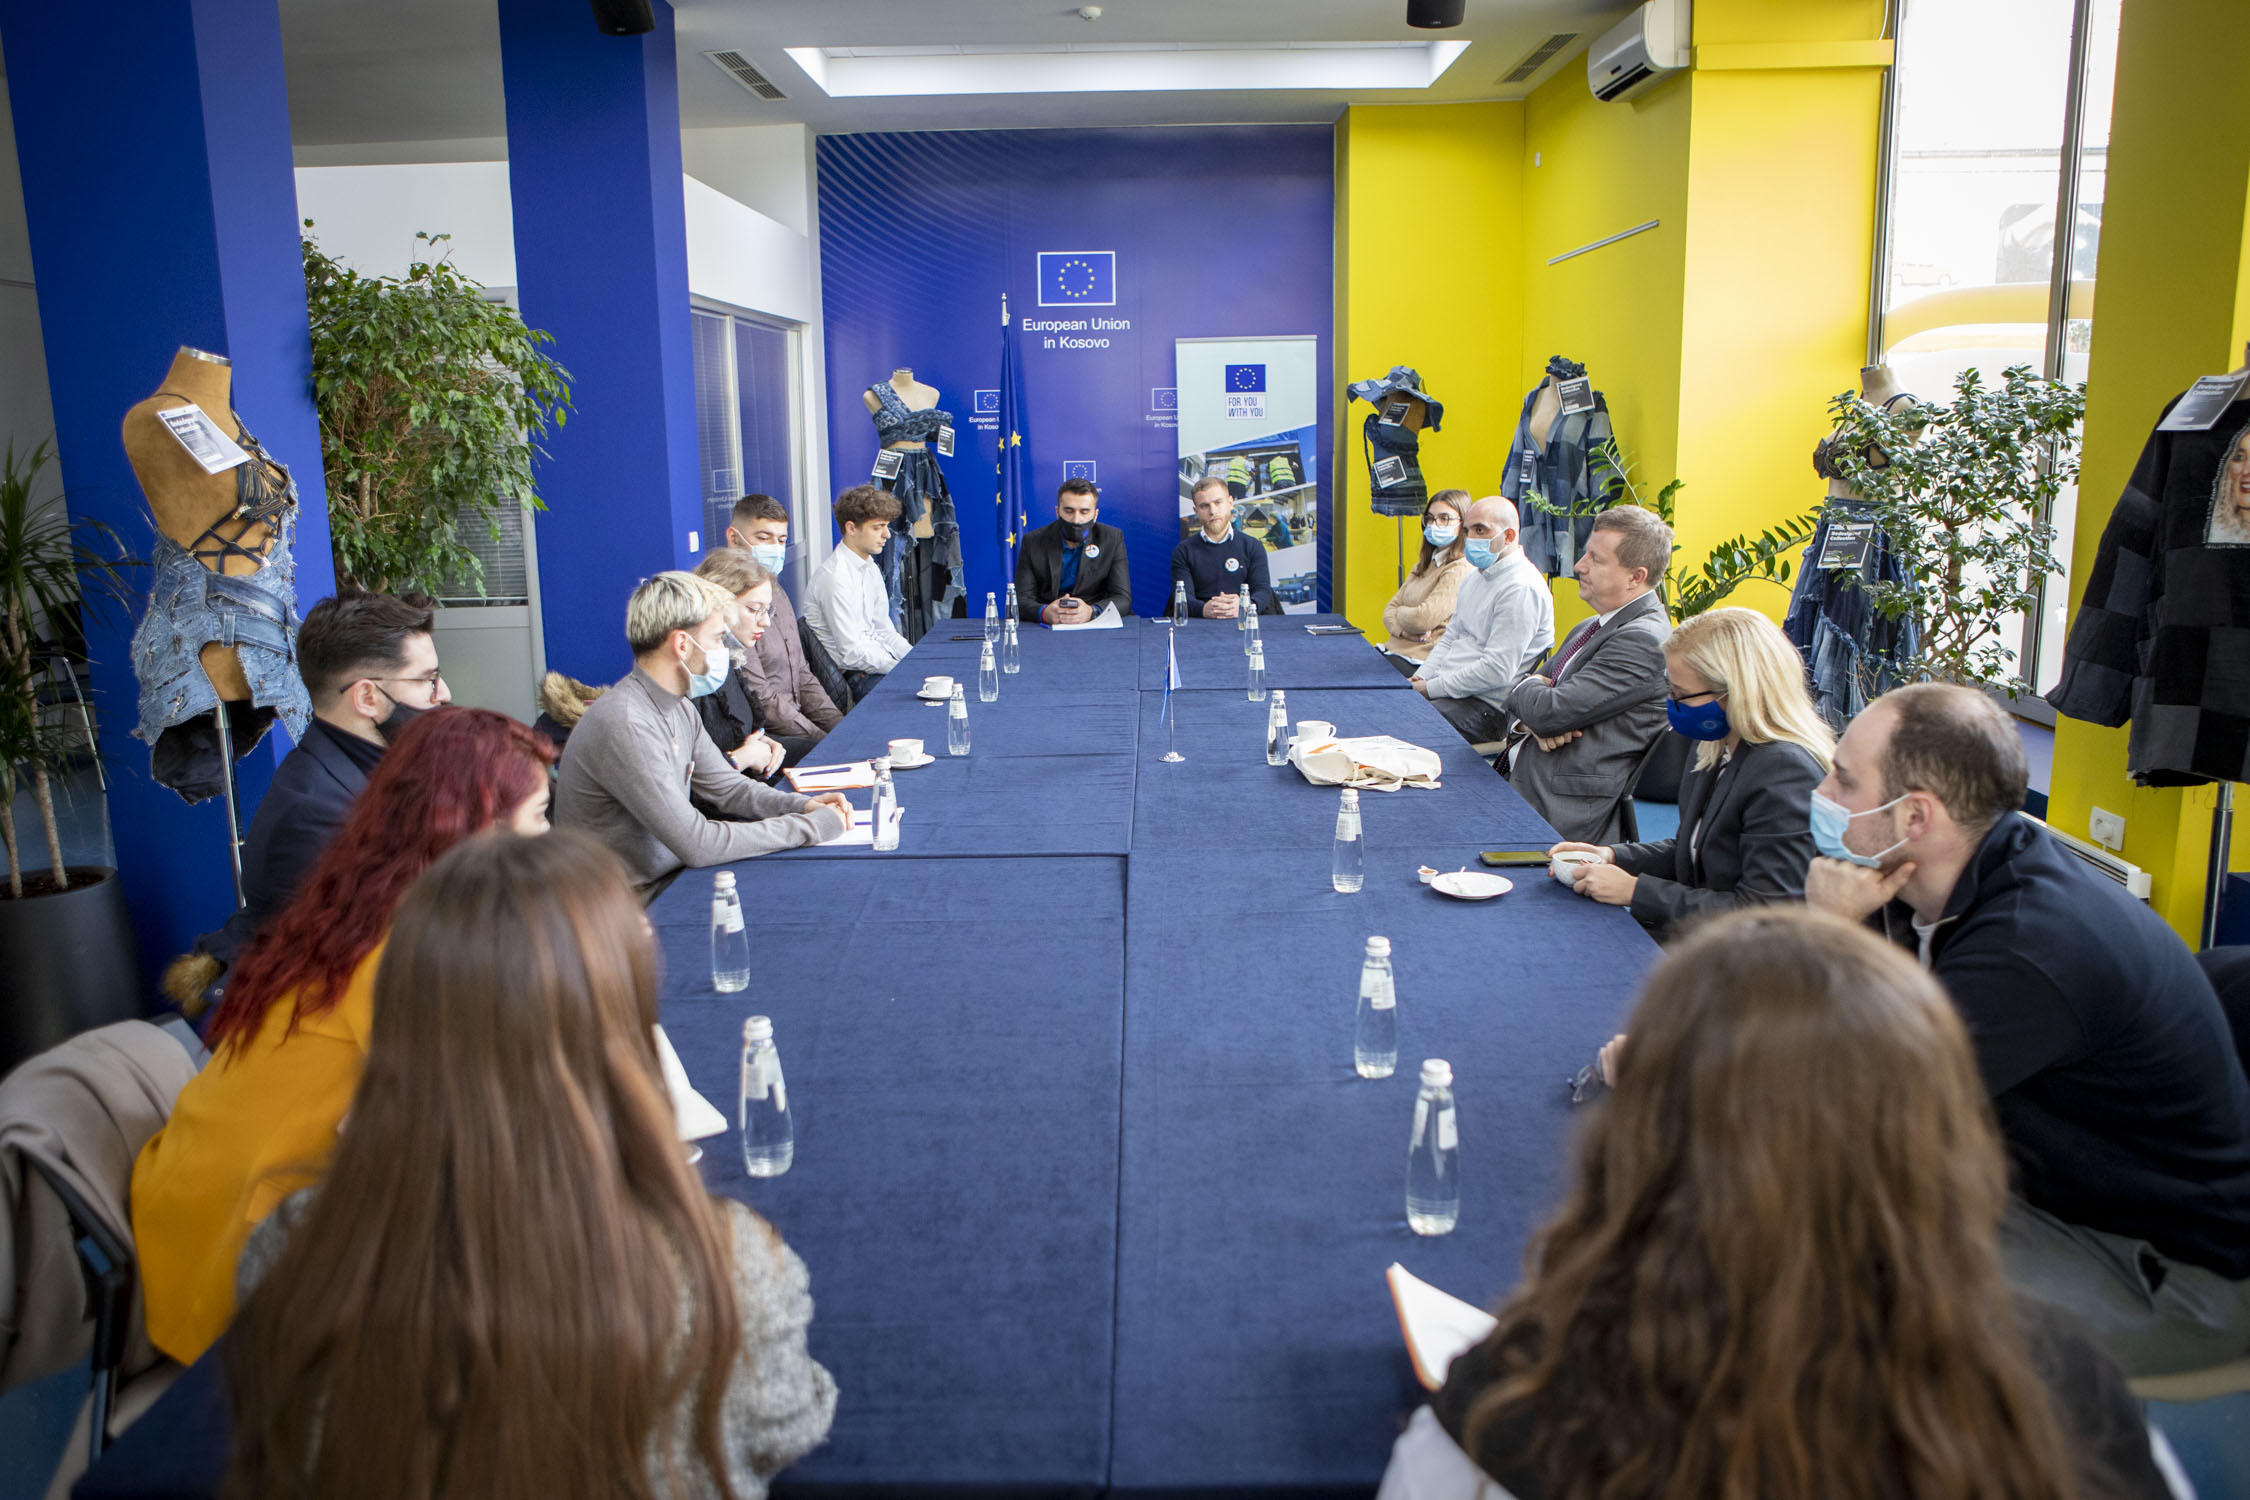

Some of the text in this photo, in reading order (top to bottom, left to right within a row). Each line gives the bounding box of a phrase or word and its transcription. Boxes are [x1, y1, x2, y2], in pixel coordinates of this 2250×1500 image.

[1023, 317, 1131, 333] European Union
[1044, 336, 1110, 349] in Kosovo
[1229, 397, 1257, 406] FOR YOU
[1229, 408, 1264, 416] WITH YOU
[969, 416, 996, 424] European
